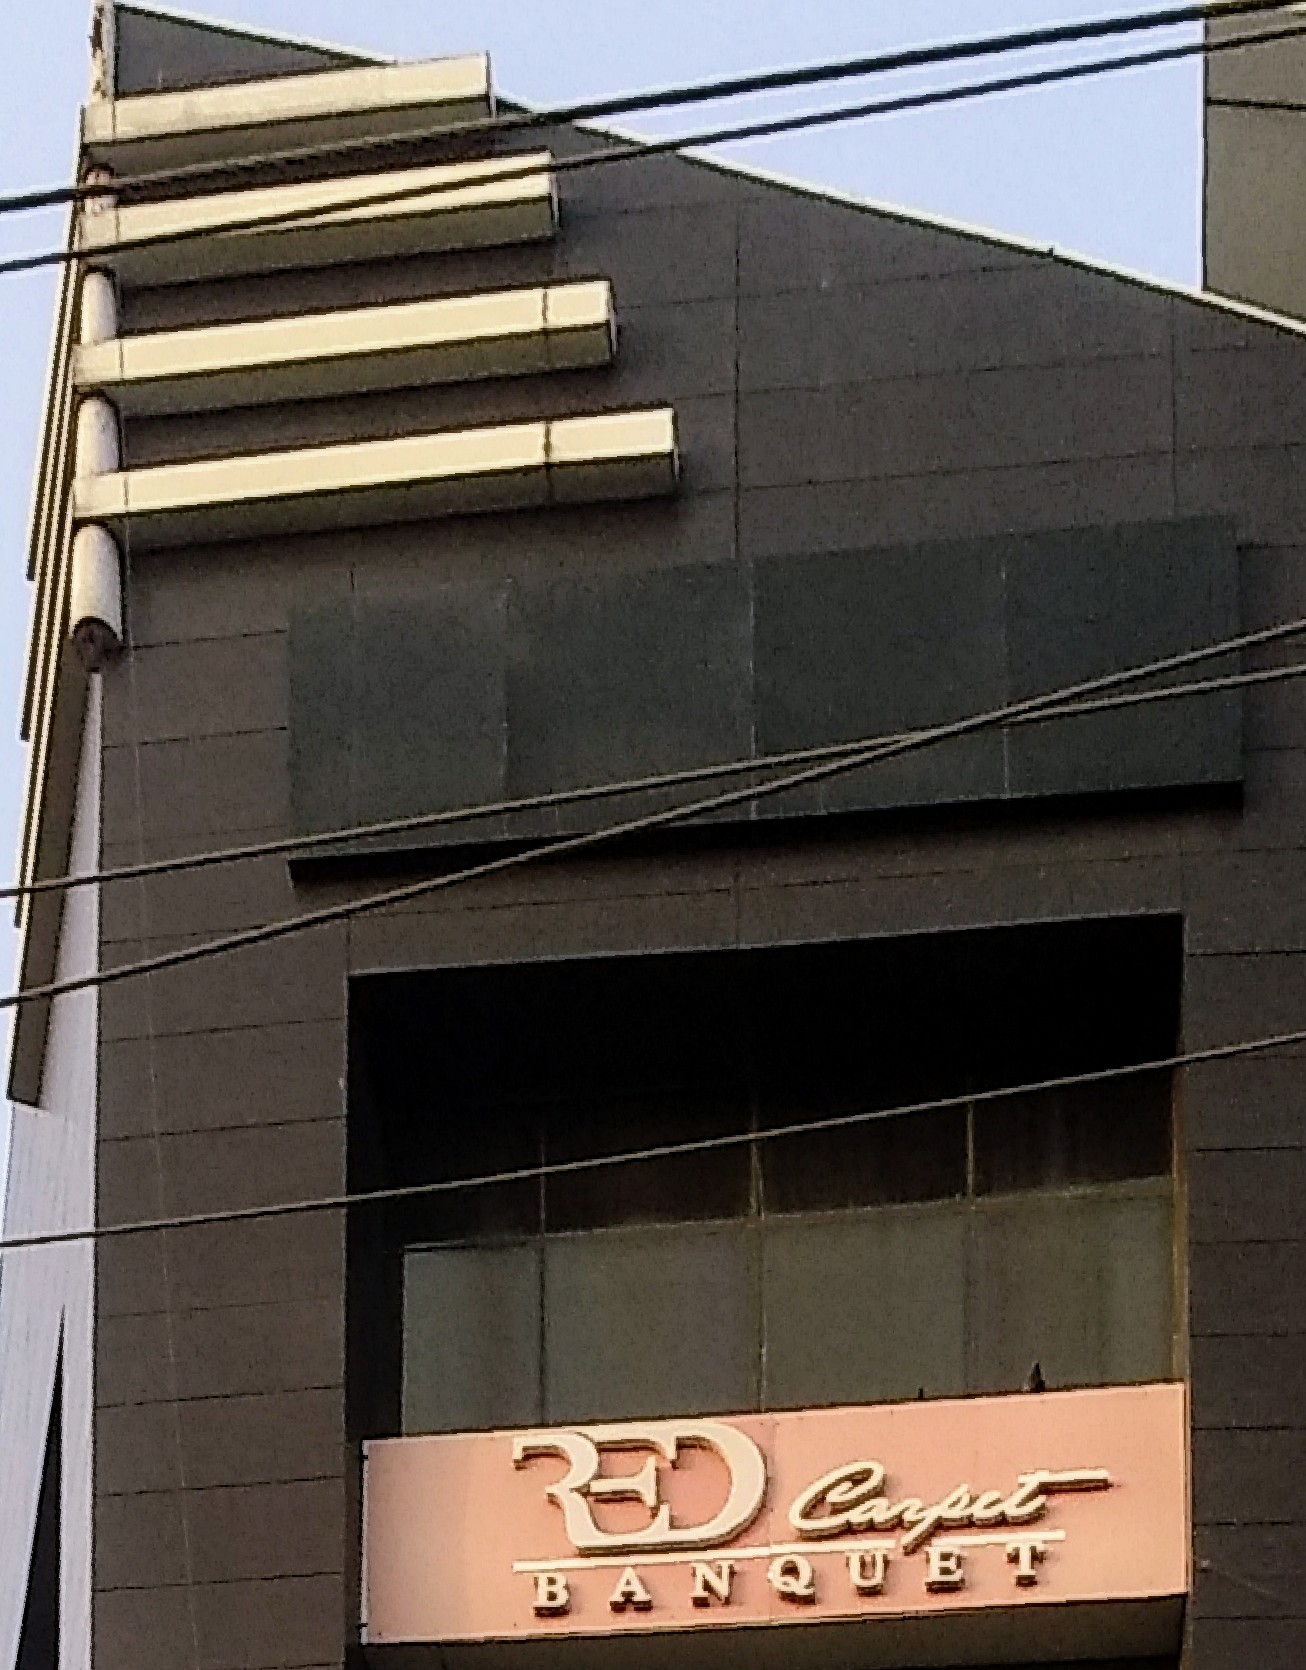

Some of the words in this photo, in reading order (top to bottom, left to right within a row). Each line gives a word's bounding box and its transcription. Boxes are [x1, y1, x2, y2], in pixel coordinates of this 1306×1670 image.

[511, 1419, 769, 1556] RED
[789, 1459, 1112, 1552] Carpet
[532, 1541, 1046, 1617] BANQUET
